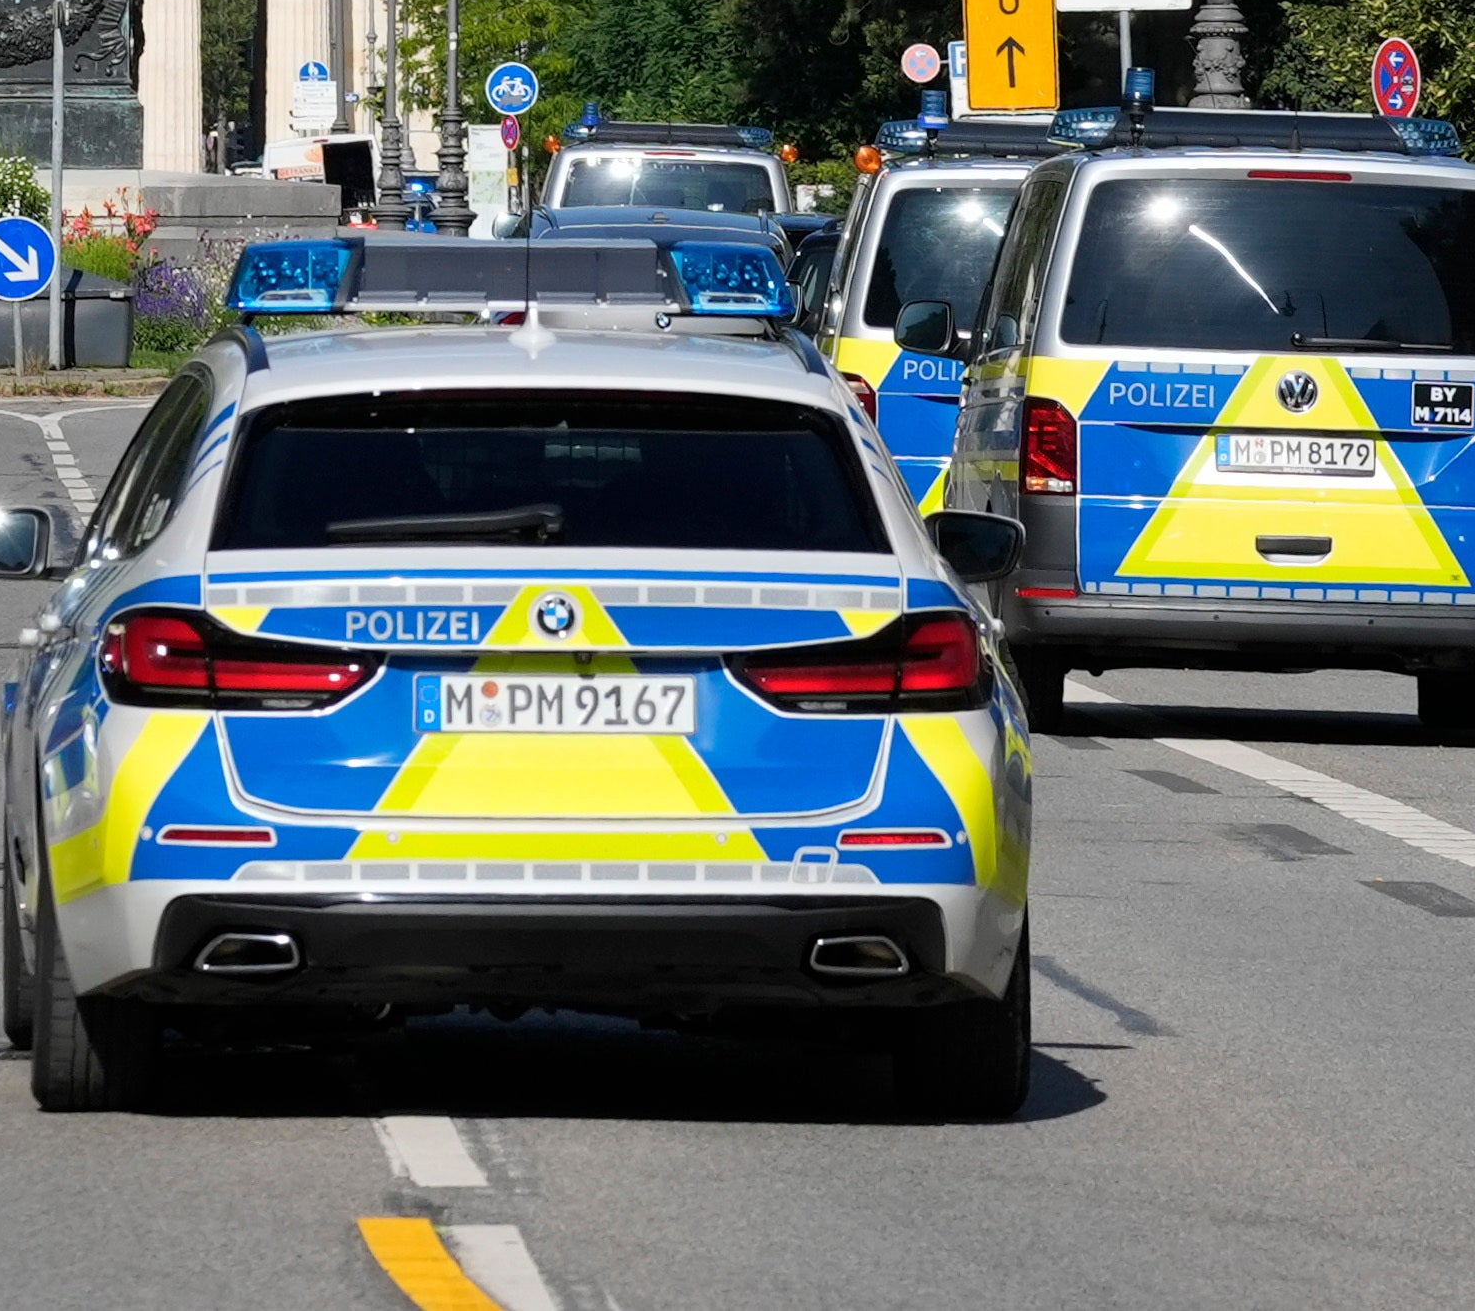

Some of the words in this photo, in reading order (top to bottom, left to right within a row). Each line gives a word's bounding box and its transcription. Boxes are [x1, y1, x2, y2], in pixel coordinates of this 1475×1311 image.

[1109, 382, 1215, 408] POLIZEI
[1430, 386, 1457, 402] BY
[1415, 406, 1430, 422] M
[1433, 407, 1472, 423] 7114
[1235, 439, 1250, 463] M
[1270, 440, 1302, 464] PM
[1308, 442, 1371, 466] 8179
[345, 610, 480, 641] POLIZEI
[445, 683, 473, 725] M
[507, 683, 564, 725] PM
[575, 684, 686, 726] 9167
